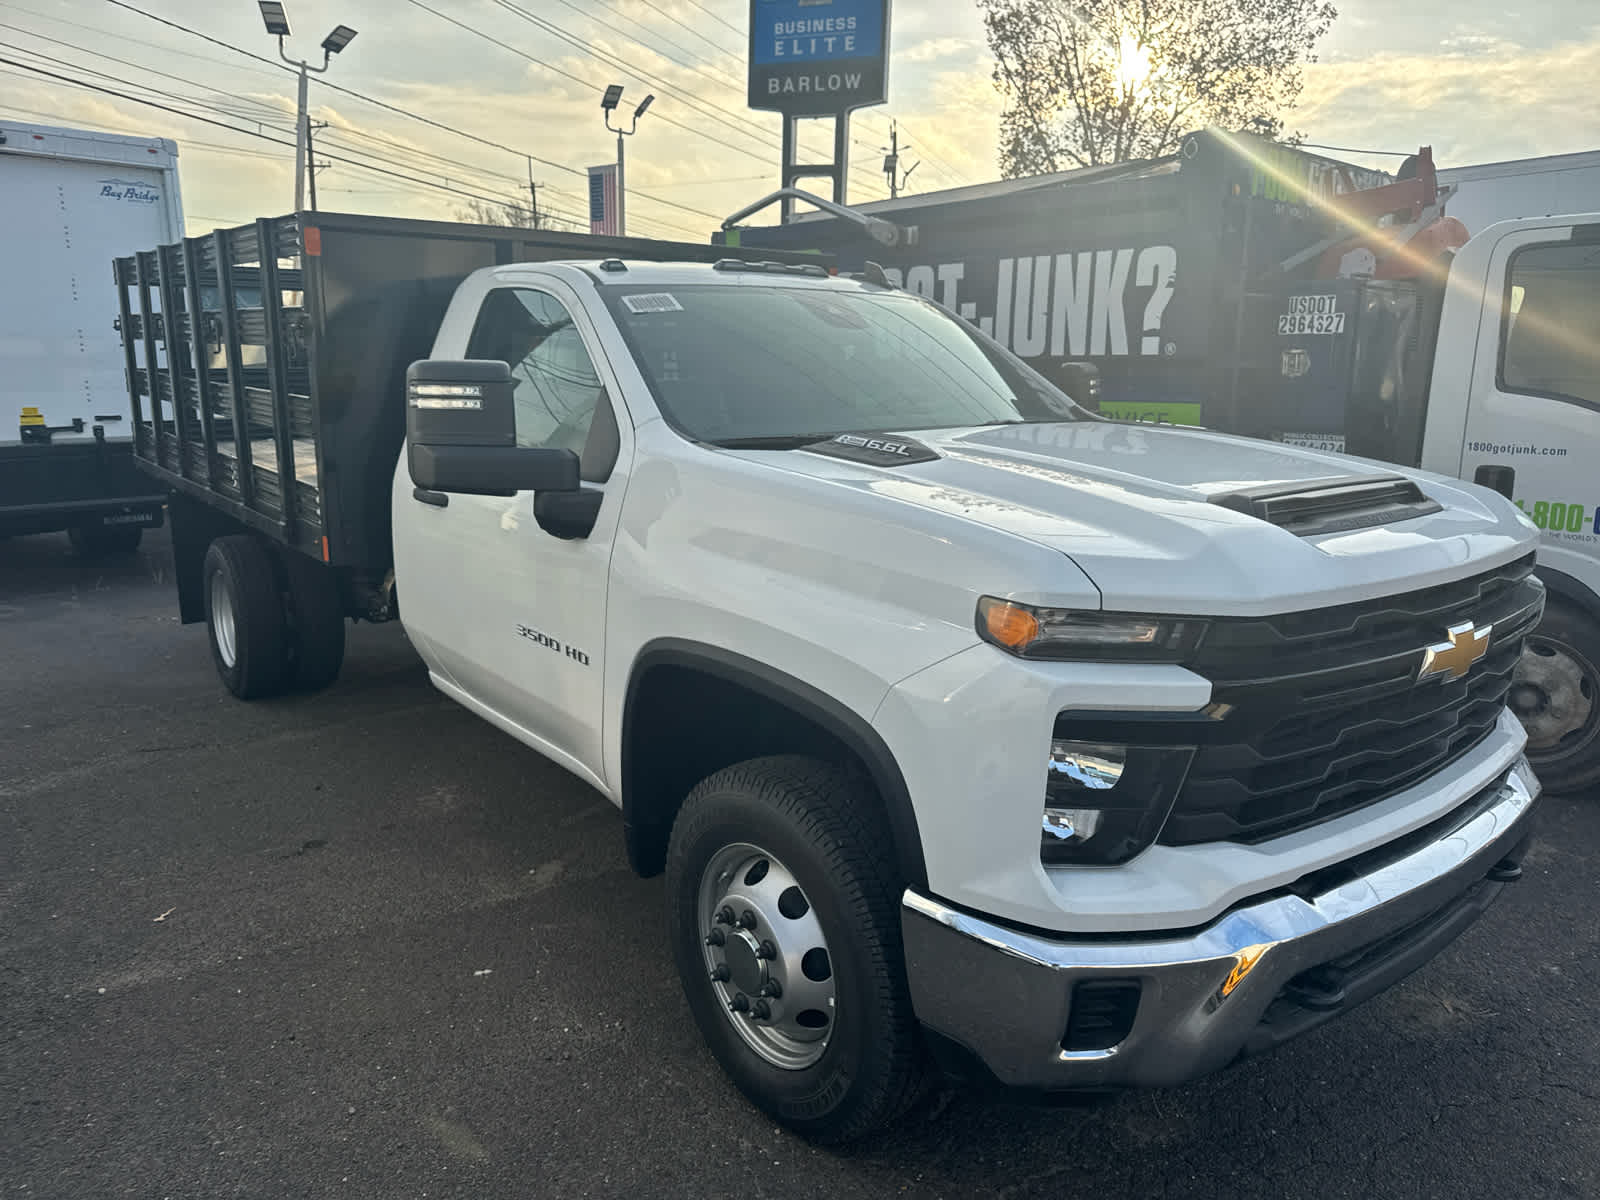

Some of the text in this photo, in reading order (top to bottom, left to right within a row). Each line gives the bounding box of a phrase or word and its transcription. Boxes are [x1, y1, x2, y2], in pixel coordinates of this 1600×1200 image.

[774, 16, 857, 35] BUSINESS
[774, 35, 856, 56] ELITE
[768, 72, 861, 94] BARLOW
[100, 185, 160, 204] Bay Bridge
[884, 246, 1177, 357] T-JUNK?
[1287, 295, 1337, 314] USDOT
[1468, 441, 1568, 456] 1800gotjunk.com
[1514, 499, 1600, 535] -800-
[515, 623, 589, 666] 3500 HD
